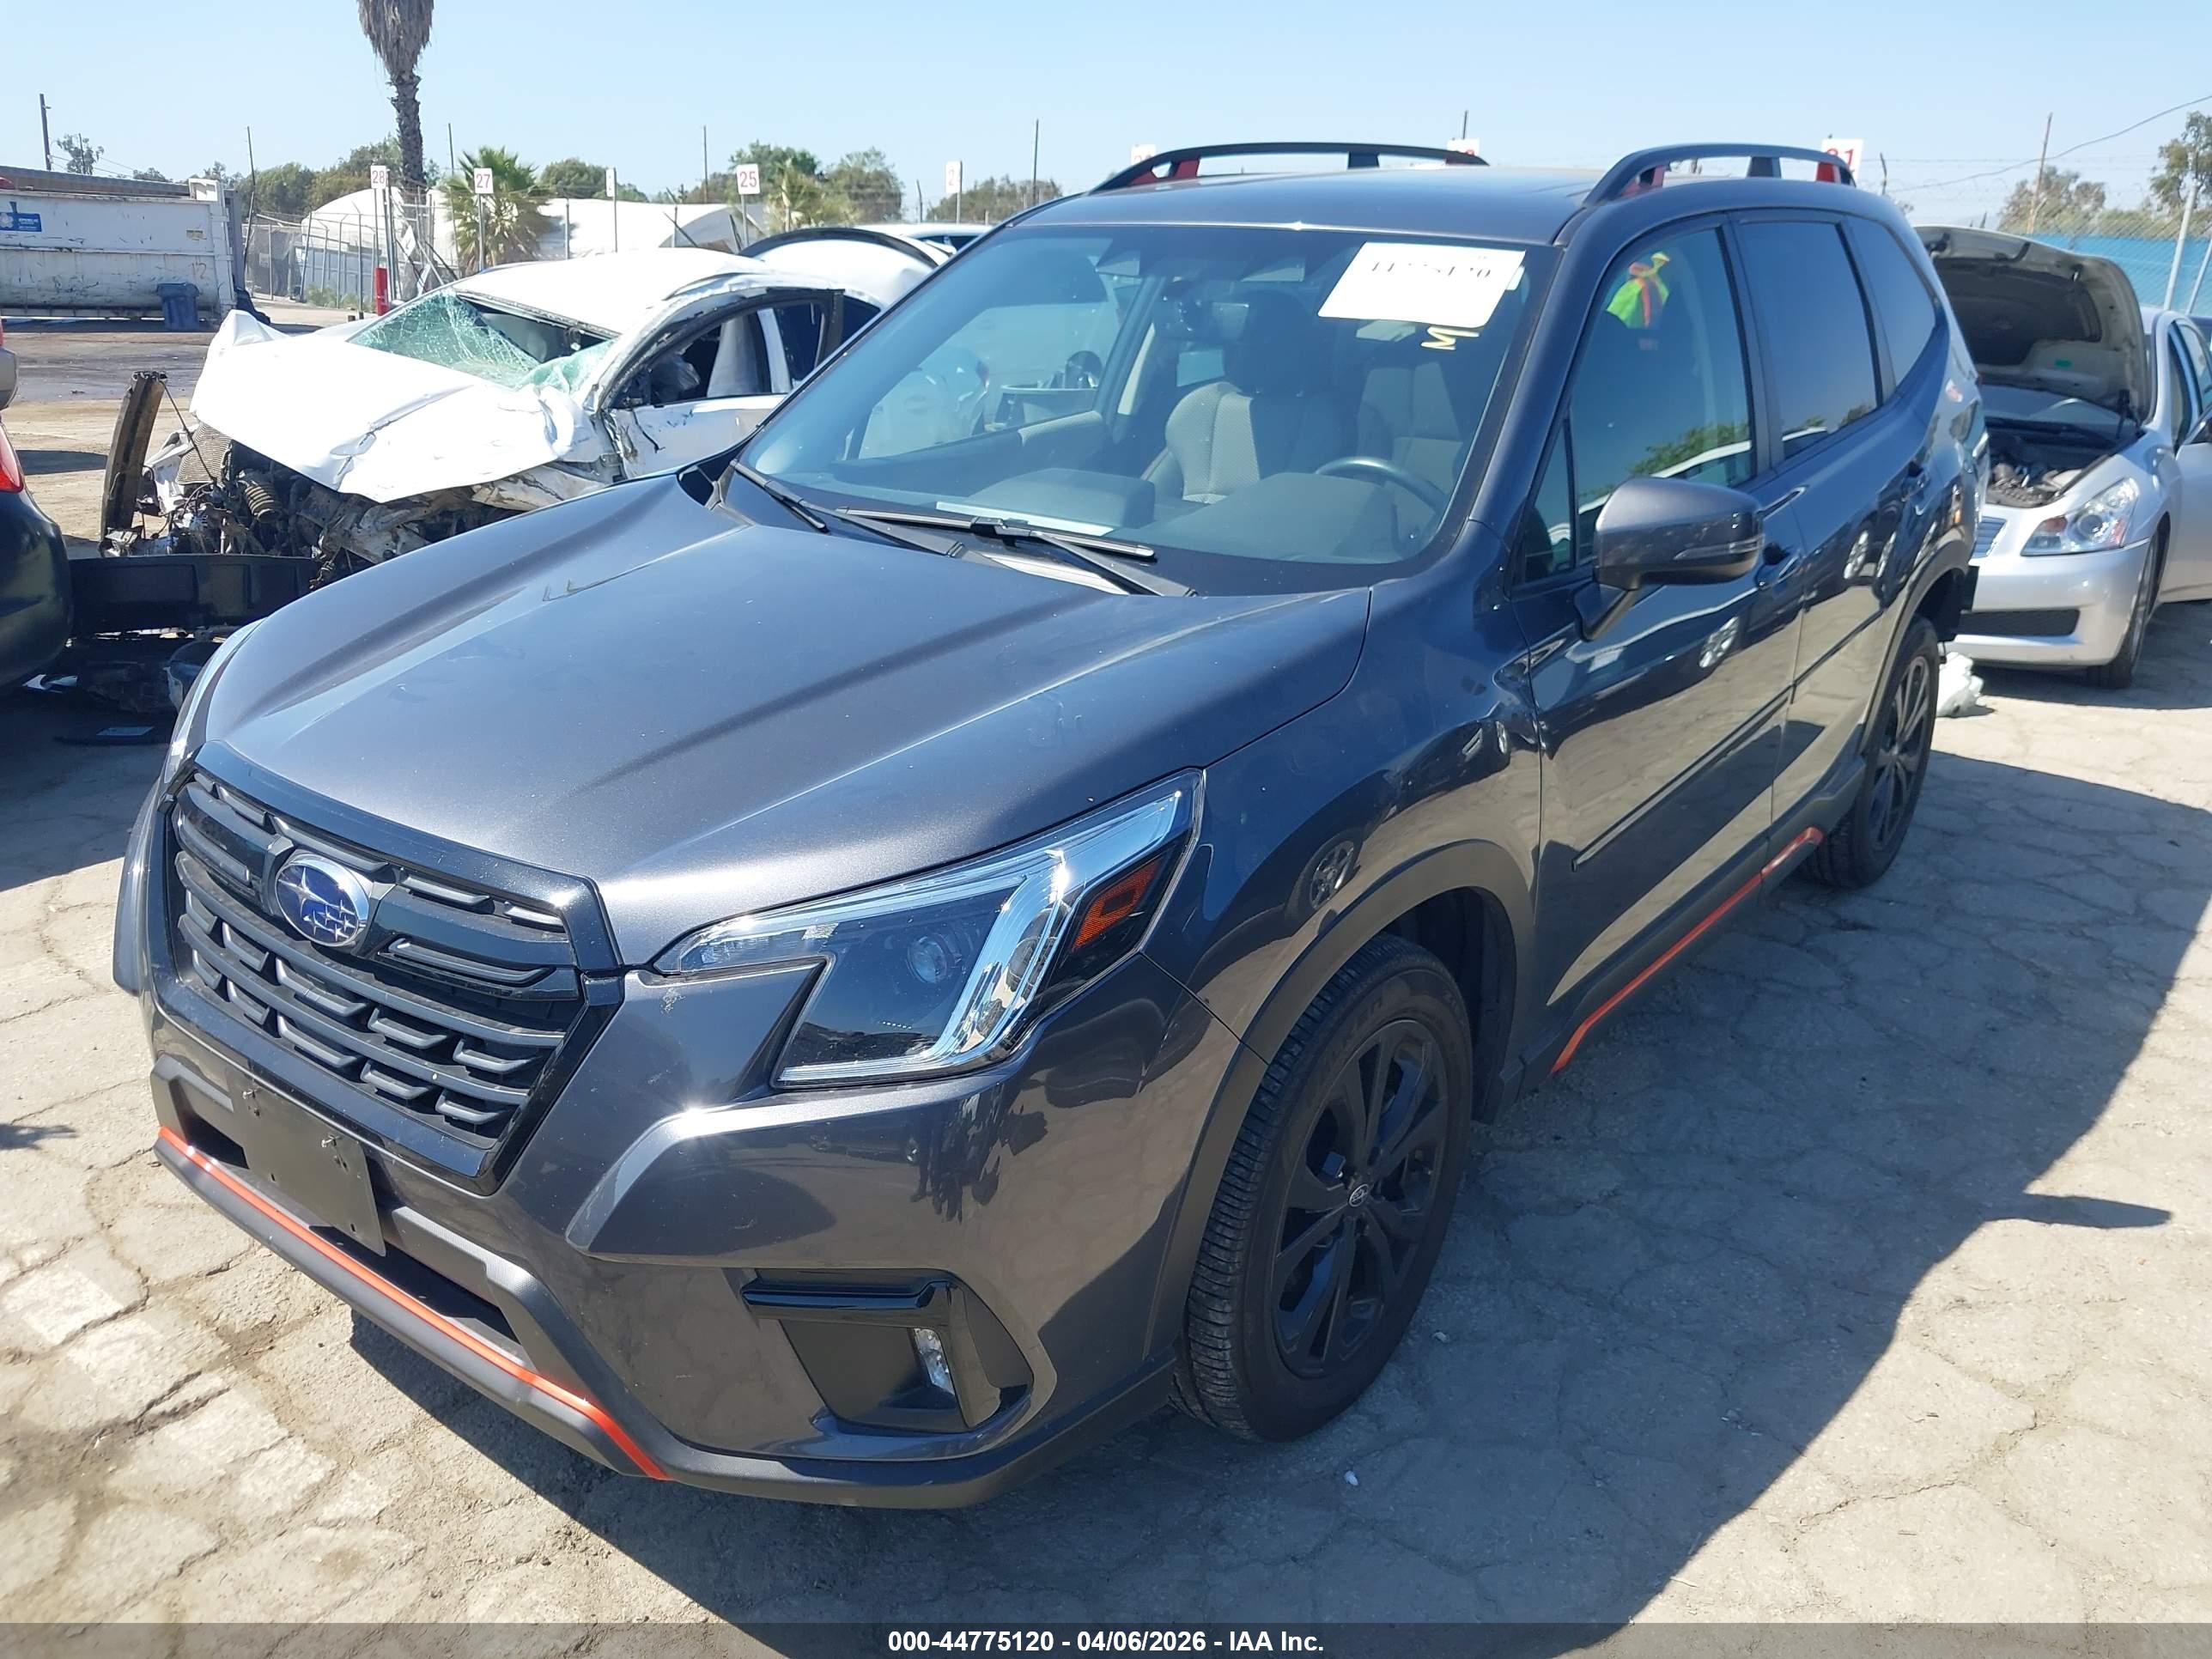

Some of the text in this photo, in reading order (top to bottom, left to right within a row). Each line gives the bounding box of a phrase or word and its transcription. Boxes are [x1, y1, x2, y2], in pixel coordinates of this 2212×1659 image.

[372, 170, 385, 184] 28
[476, 173, 491, 188] 27
[739, 171, 757, 188] 25
